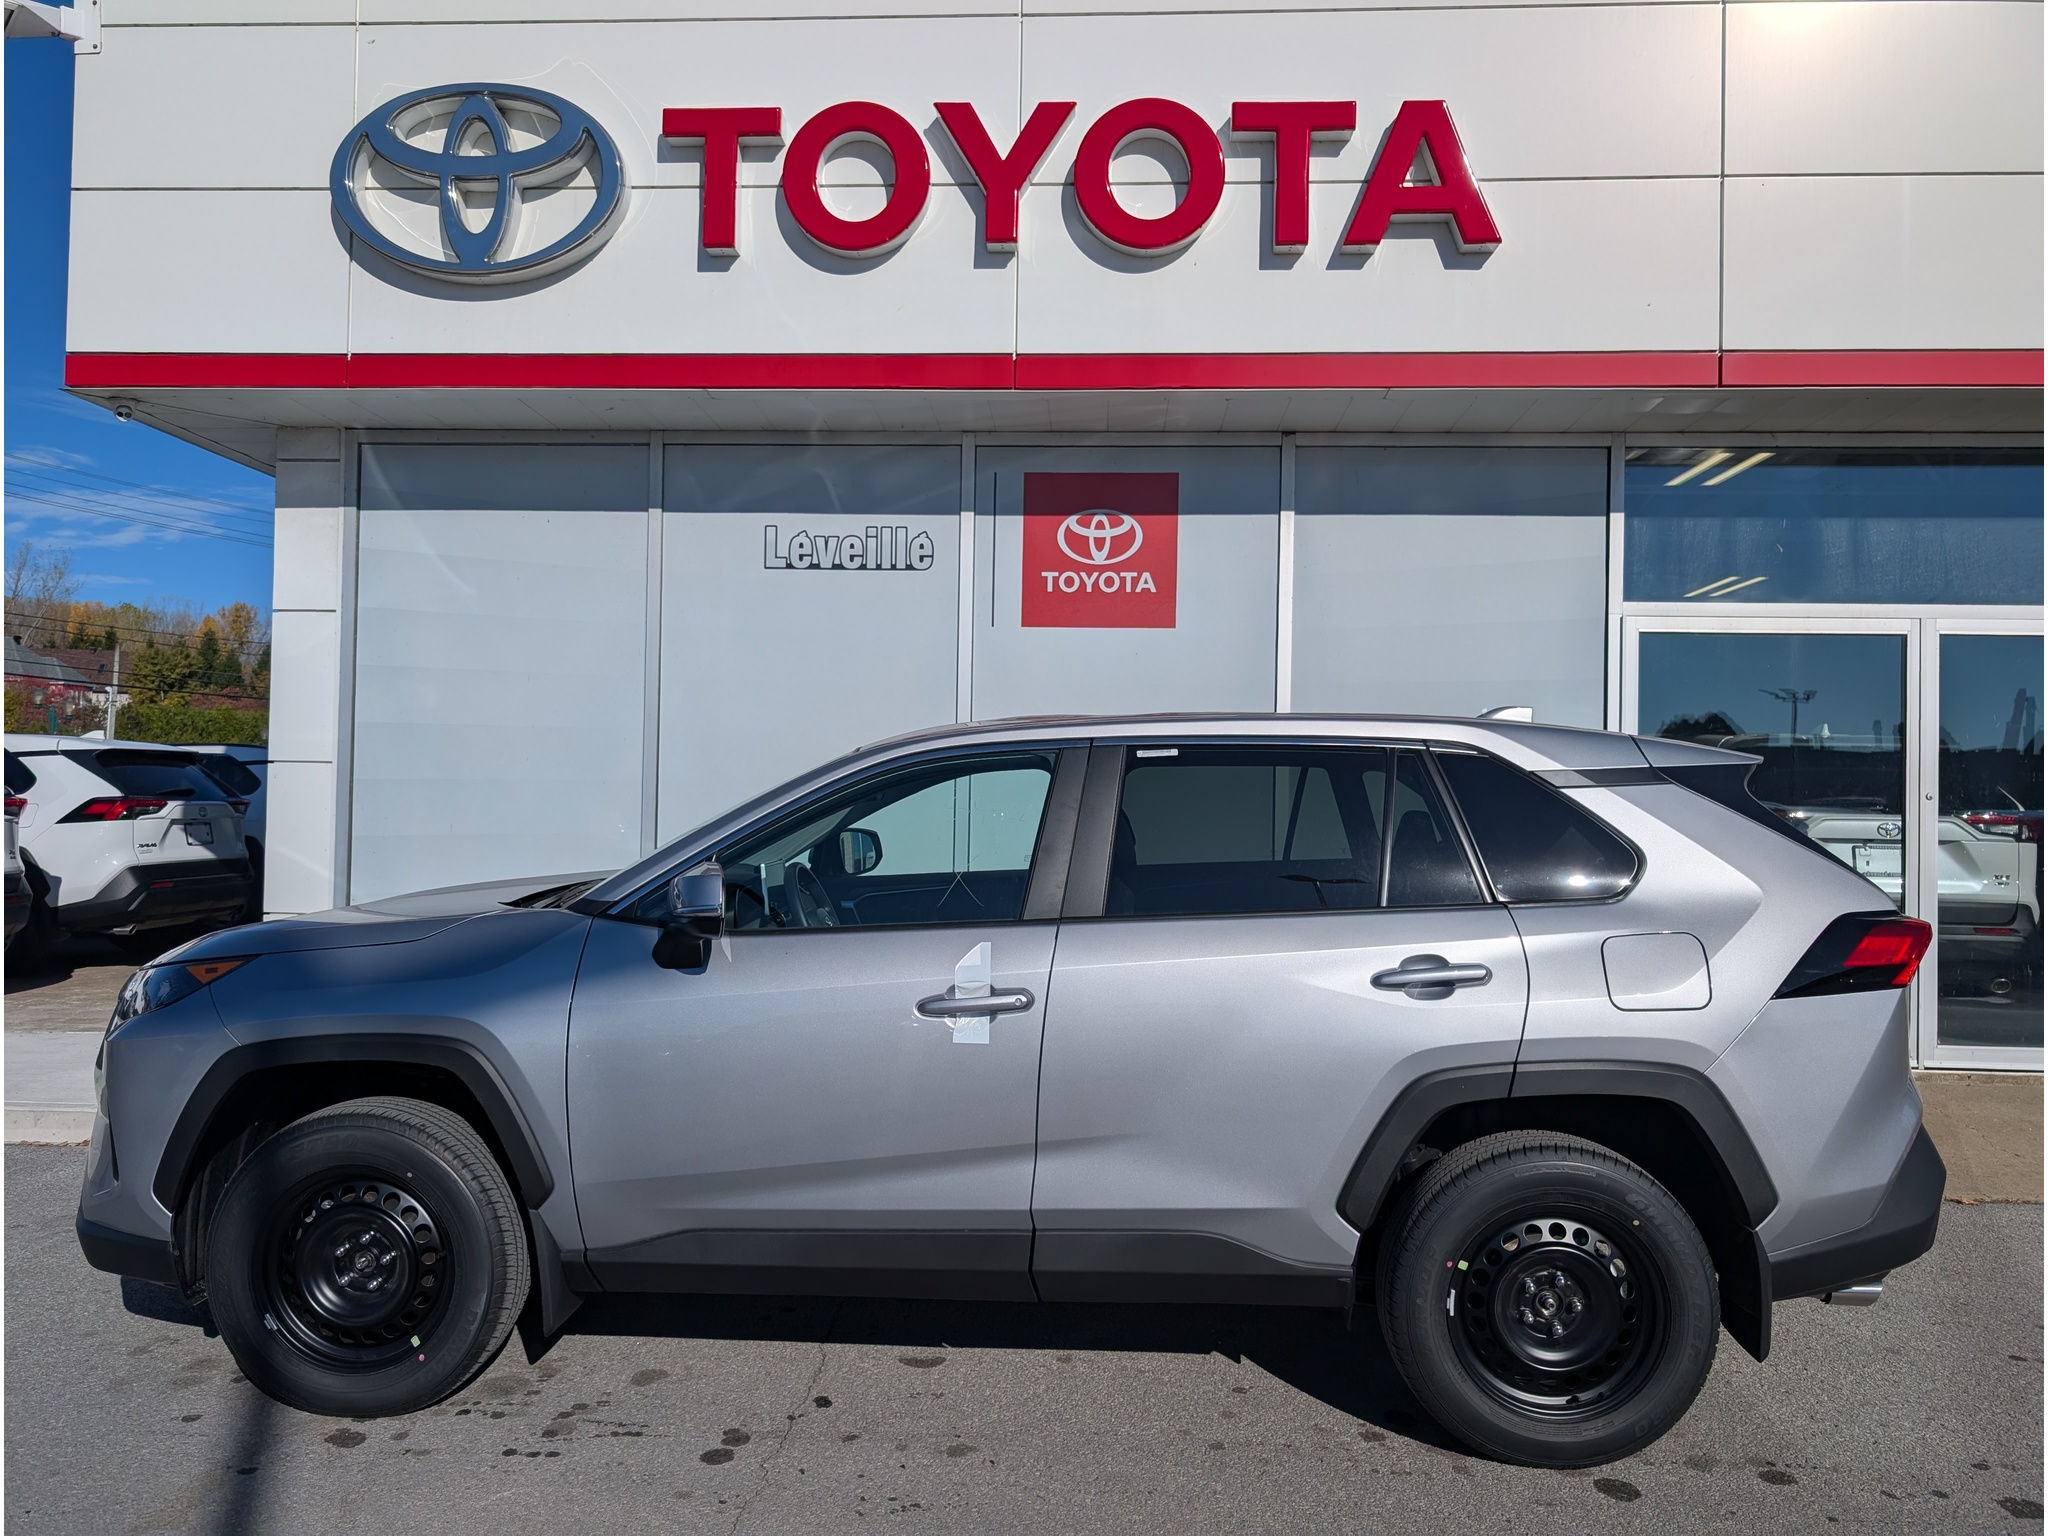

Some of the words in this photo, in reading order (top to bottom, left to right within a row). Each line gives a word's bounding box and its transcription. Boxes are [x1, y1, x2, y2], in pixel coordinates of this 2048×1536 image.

[662, 97, 1502, 254] TOYOTA
[764, 525, 935, 571] Léveillé
[1041, 571, 1157, 593] TOYOTA
